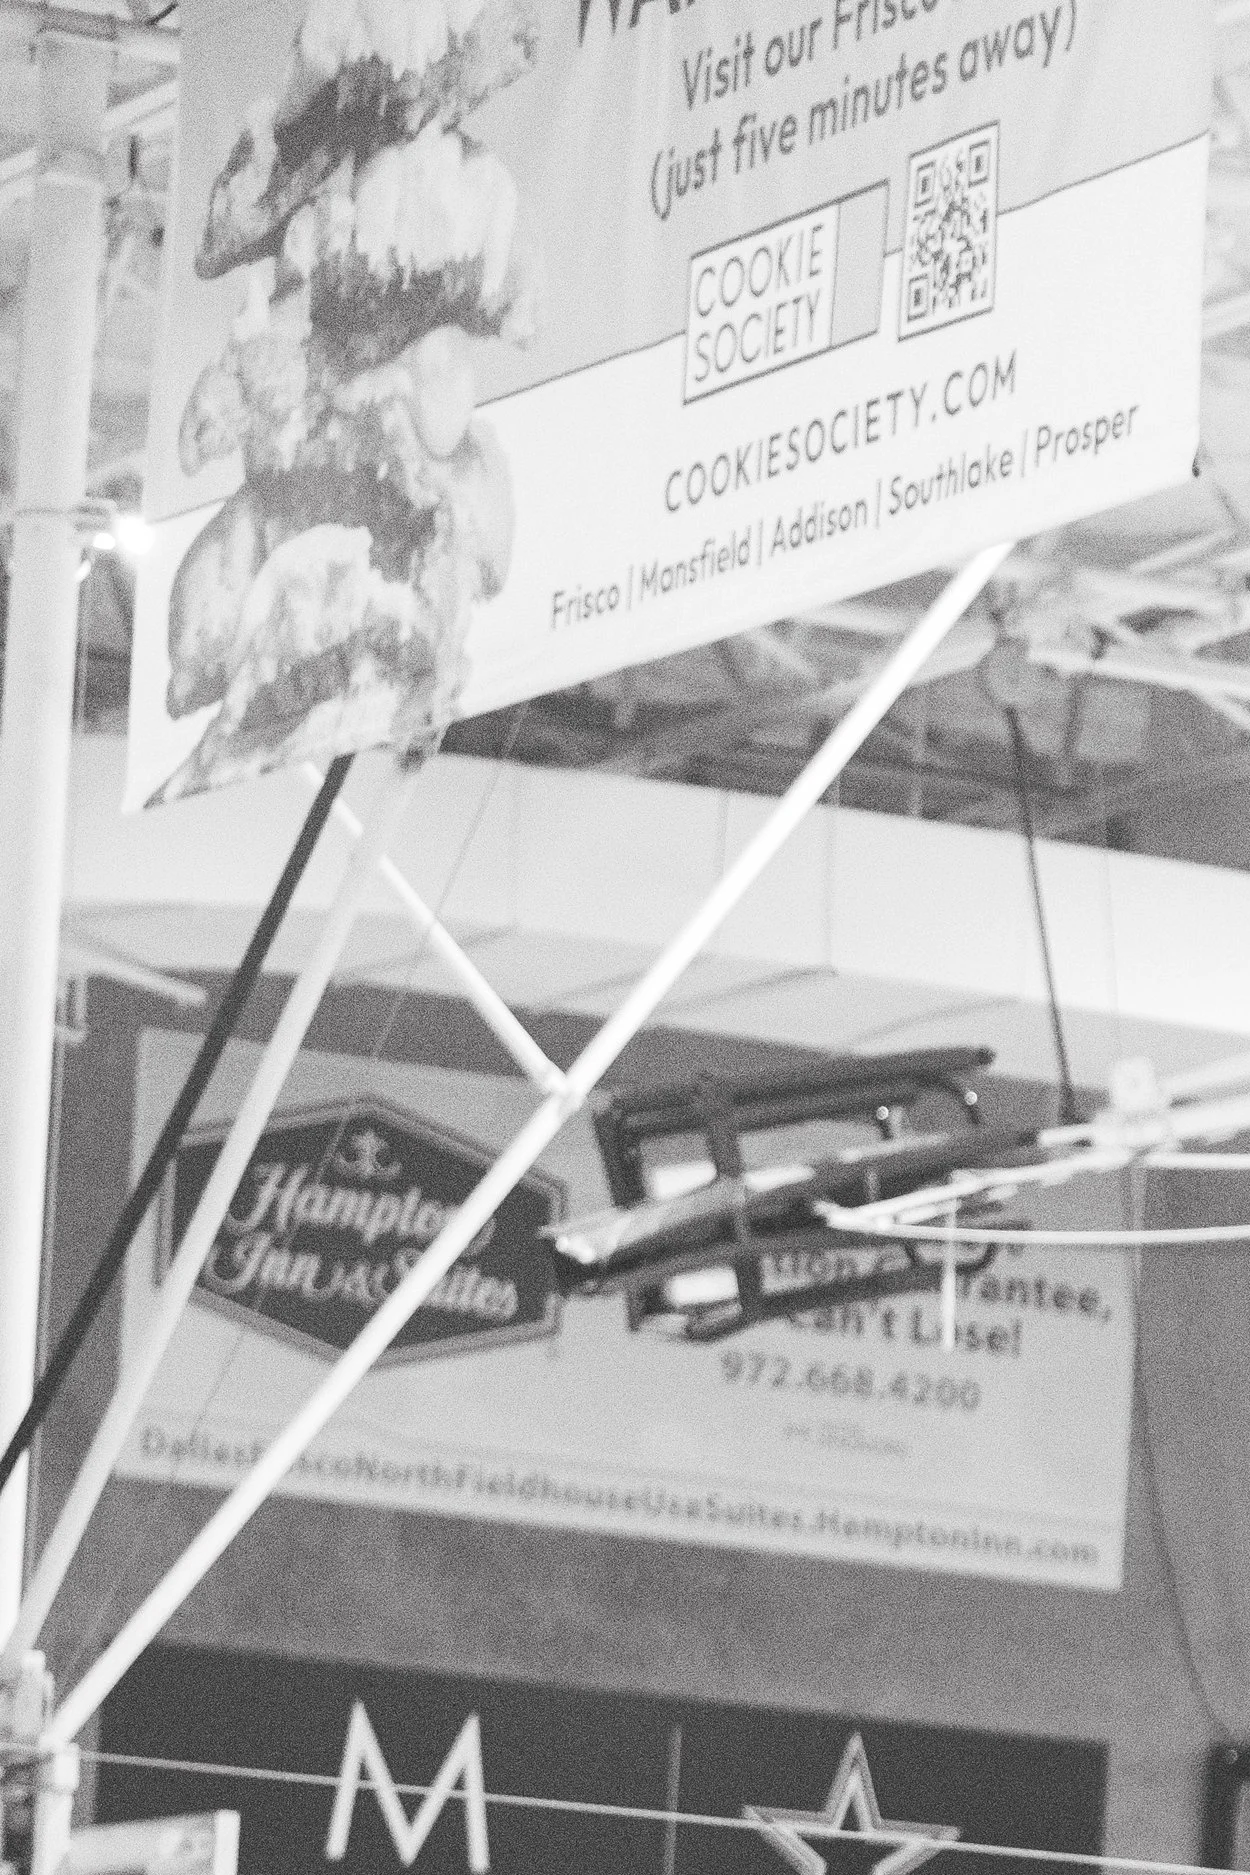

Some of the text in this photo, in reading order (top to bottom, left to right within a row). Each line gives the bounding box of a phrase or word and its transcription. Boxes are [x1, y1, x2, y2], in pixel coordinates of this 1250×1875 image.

[650, 0, 1078, 221] (just five minutes away)
[682, 30, 754, 112] Visit
[764, 16, 822, 78] our
[695, 222, 826, 319] COOKIE
[694, 287, 822, 384] SOCIETY
[664, 347, 1018, 514] COOKIESOCIETY.COM
[550, 580, 621, 630] Frisco
[637, 526, 752, 602] Mansfield
[768, 494, 868, 559] Addison
[887, 444, 1015, 517] Southlake
[1033, 404, 1140, 470] Prosper
[720, 1349, 982, 1411] 972.668.4200
